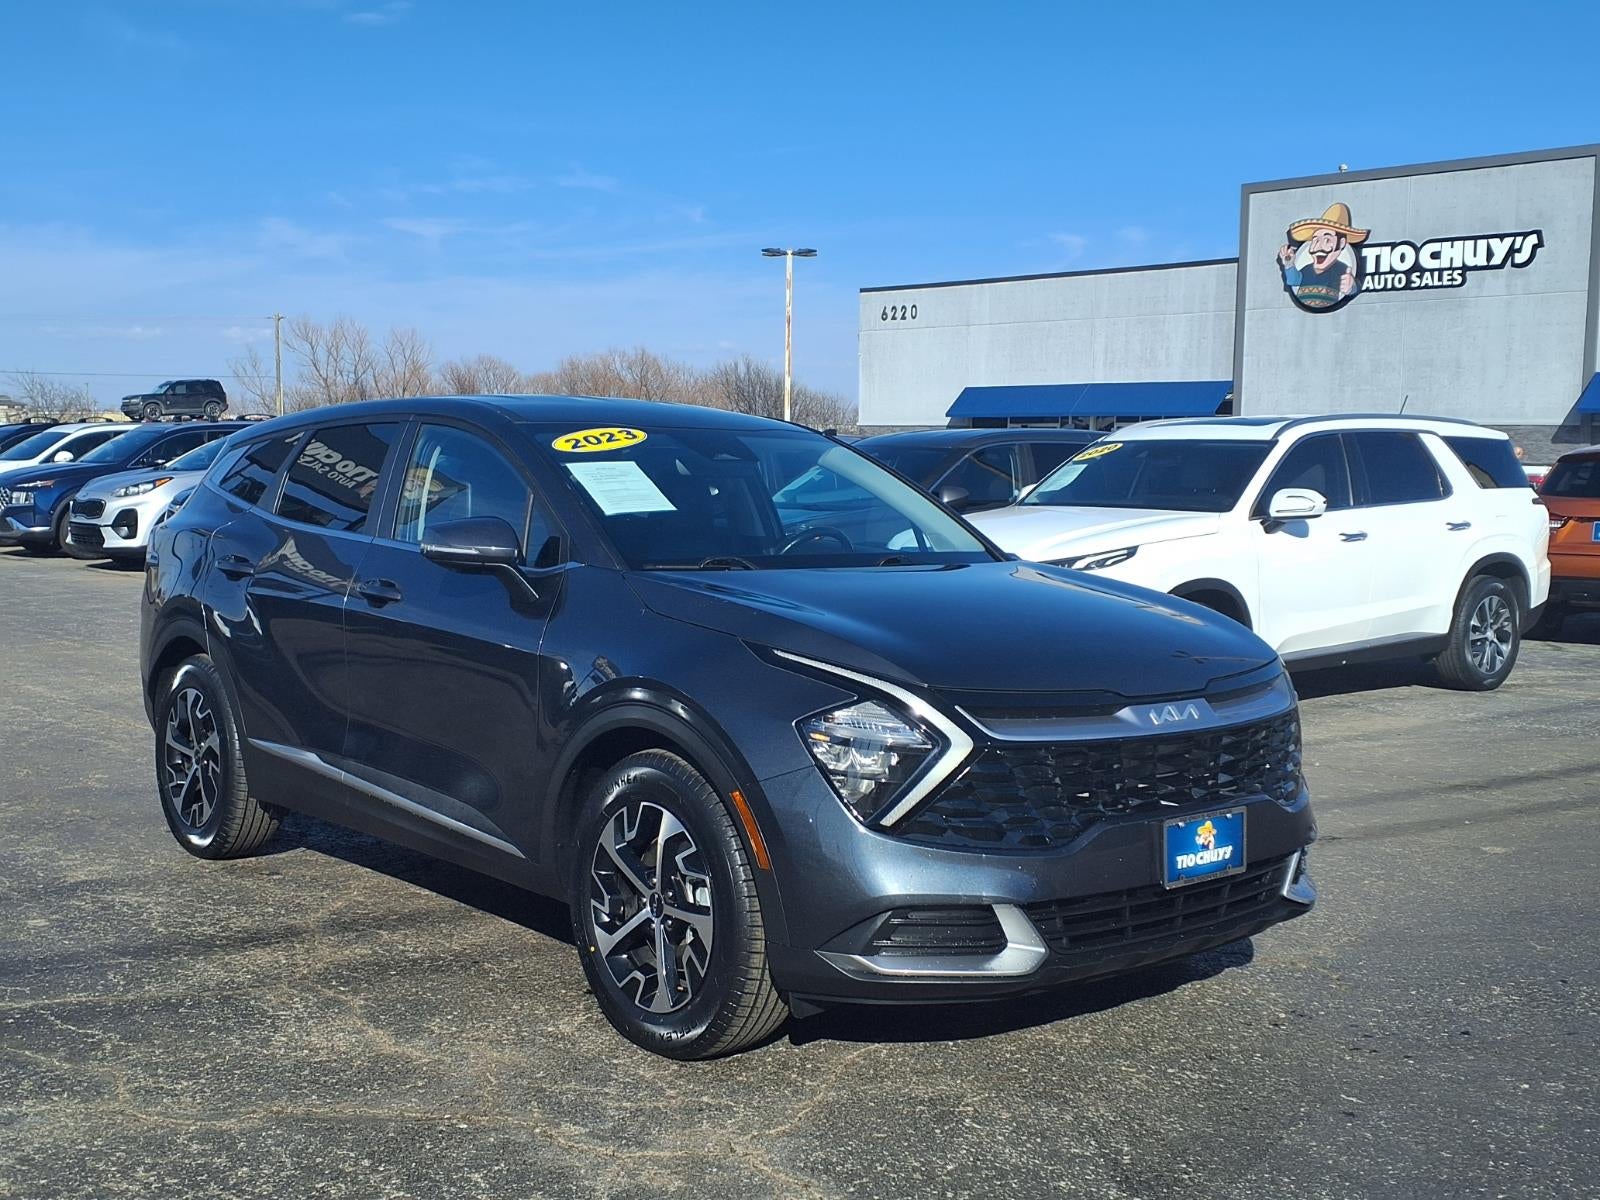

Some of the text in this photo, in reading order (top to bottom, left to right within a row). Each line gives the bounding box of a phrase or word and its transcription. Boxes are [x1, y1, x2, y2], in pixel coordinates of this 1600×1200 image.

[1361, 234, 1538, 273] TIO CHUY'S
[1361, 270, 1463, 291] AUTO SALES
[881, 304, 918, 321] 6220
[565, 430, 638, 449] 2023
[1150, 703, 1200, 725] KIA
[1176, 853, 1196, 869] TIO
